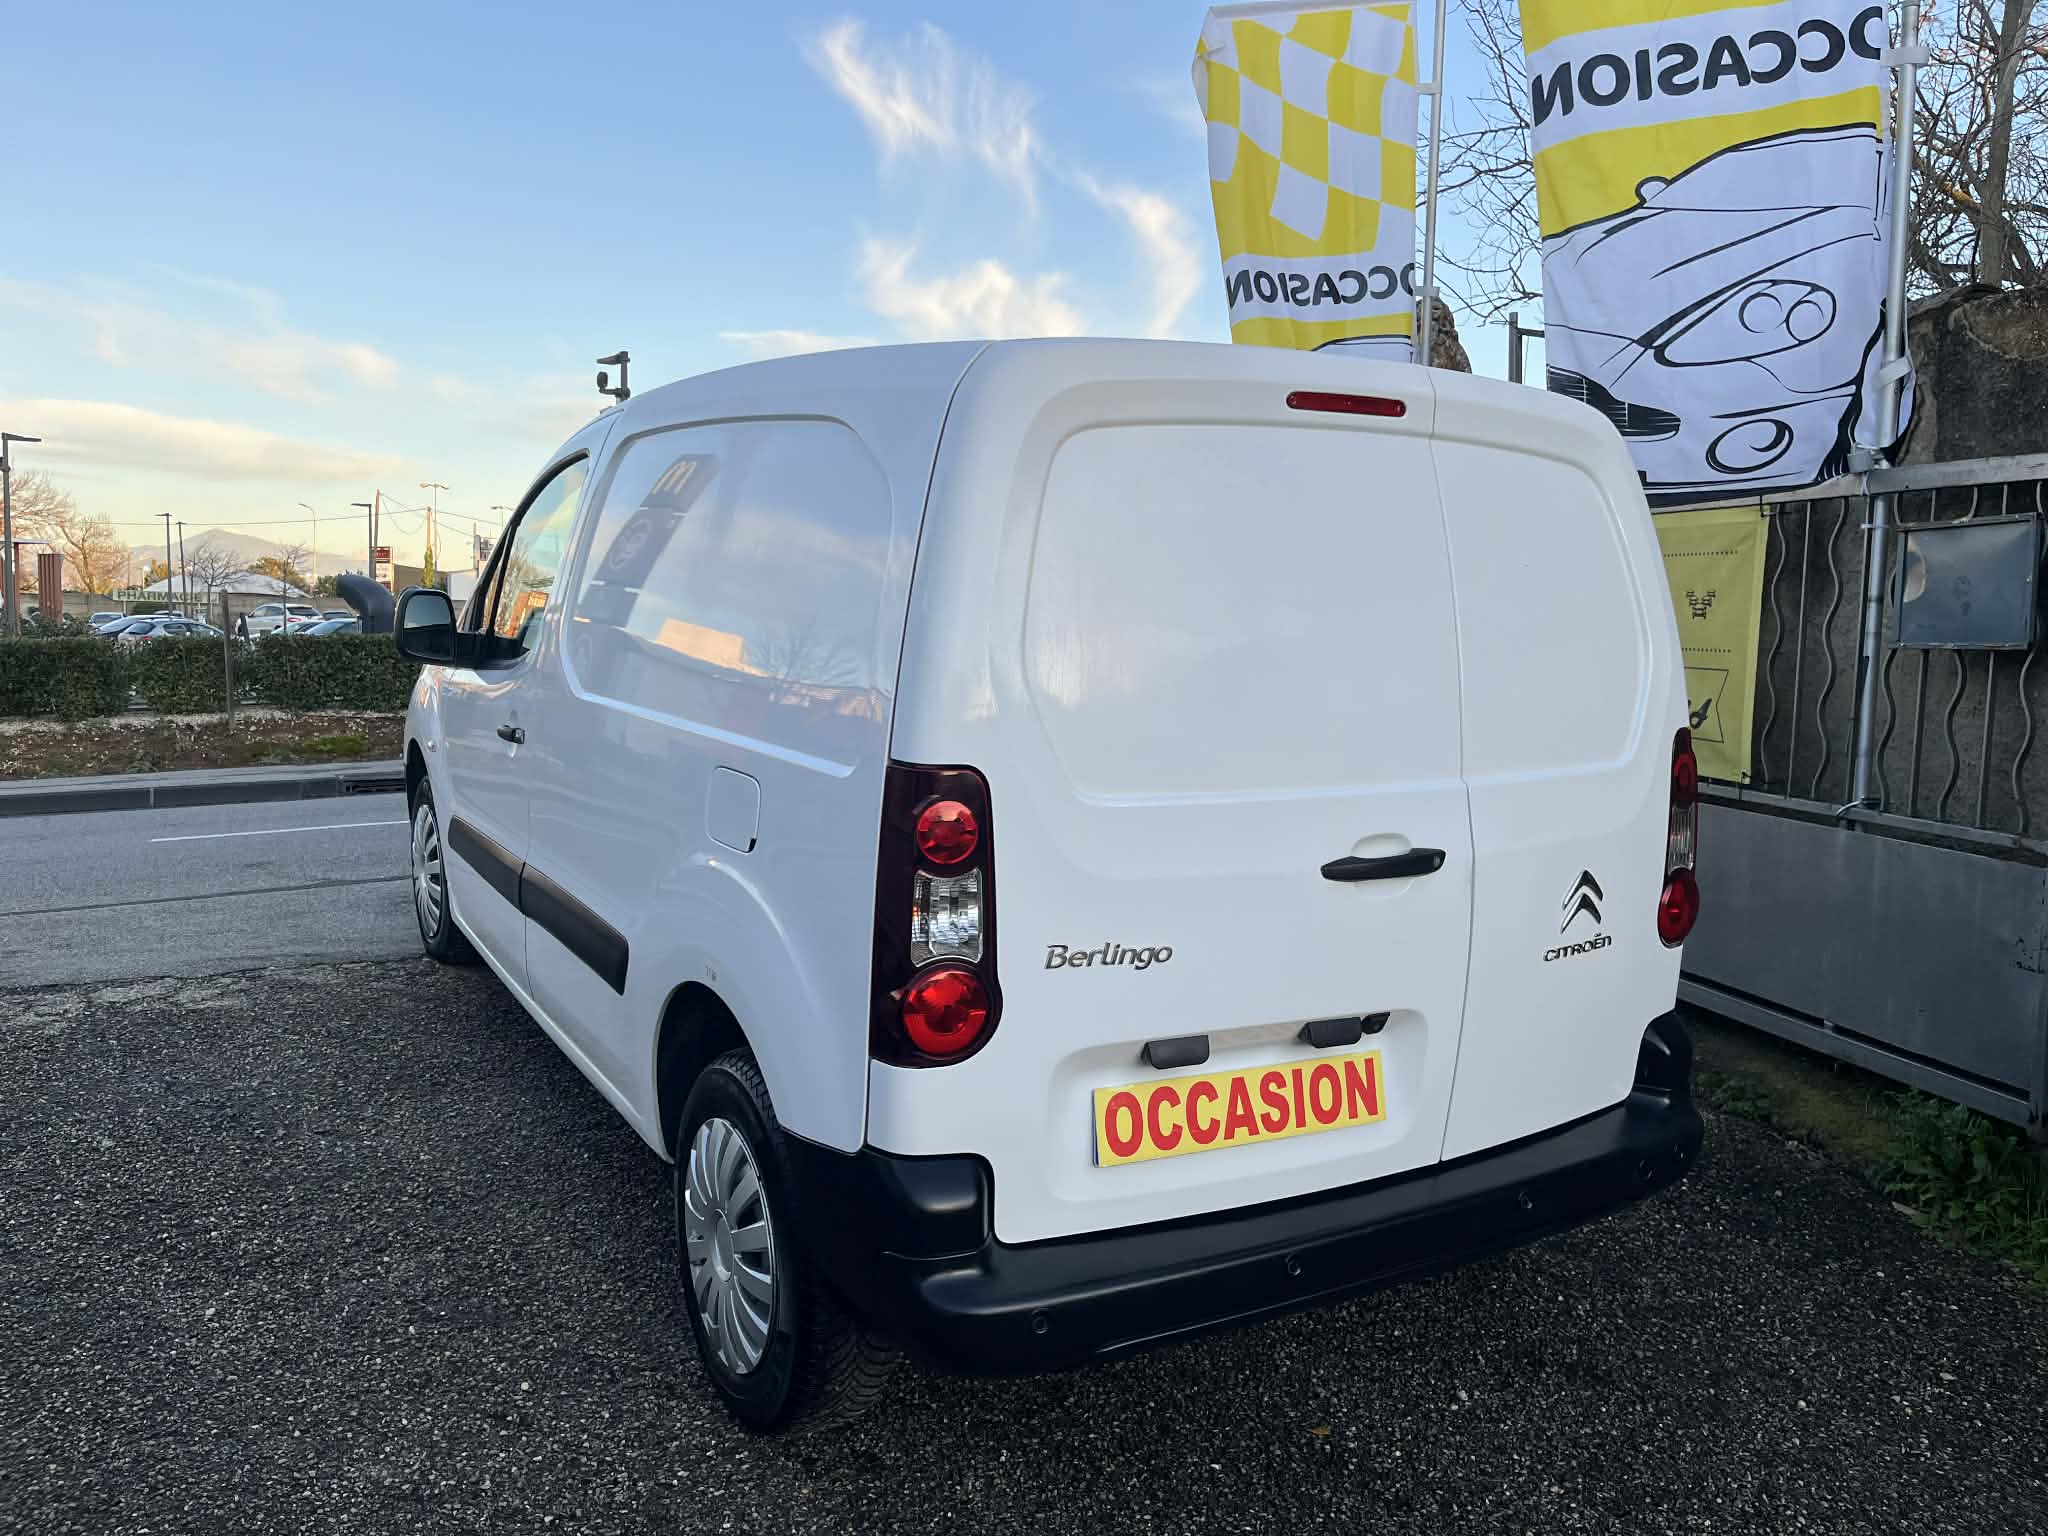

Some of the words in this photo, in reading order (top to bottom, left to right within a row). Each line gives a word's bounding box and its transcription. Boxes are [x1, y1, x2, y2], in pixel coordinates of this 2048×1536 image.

[117, 590, 202, 602] PHARMACE
[1045, 941, 1173, 970] Berlingo
[1104, 1057, 1379, 1158] OCCASION
